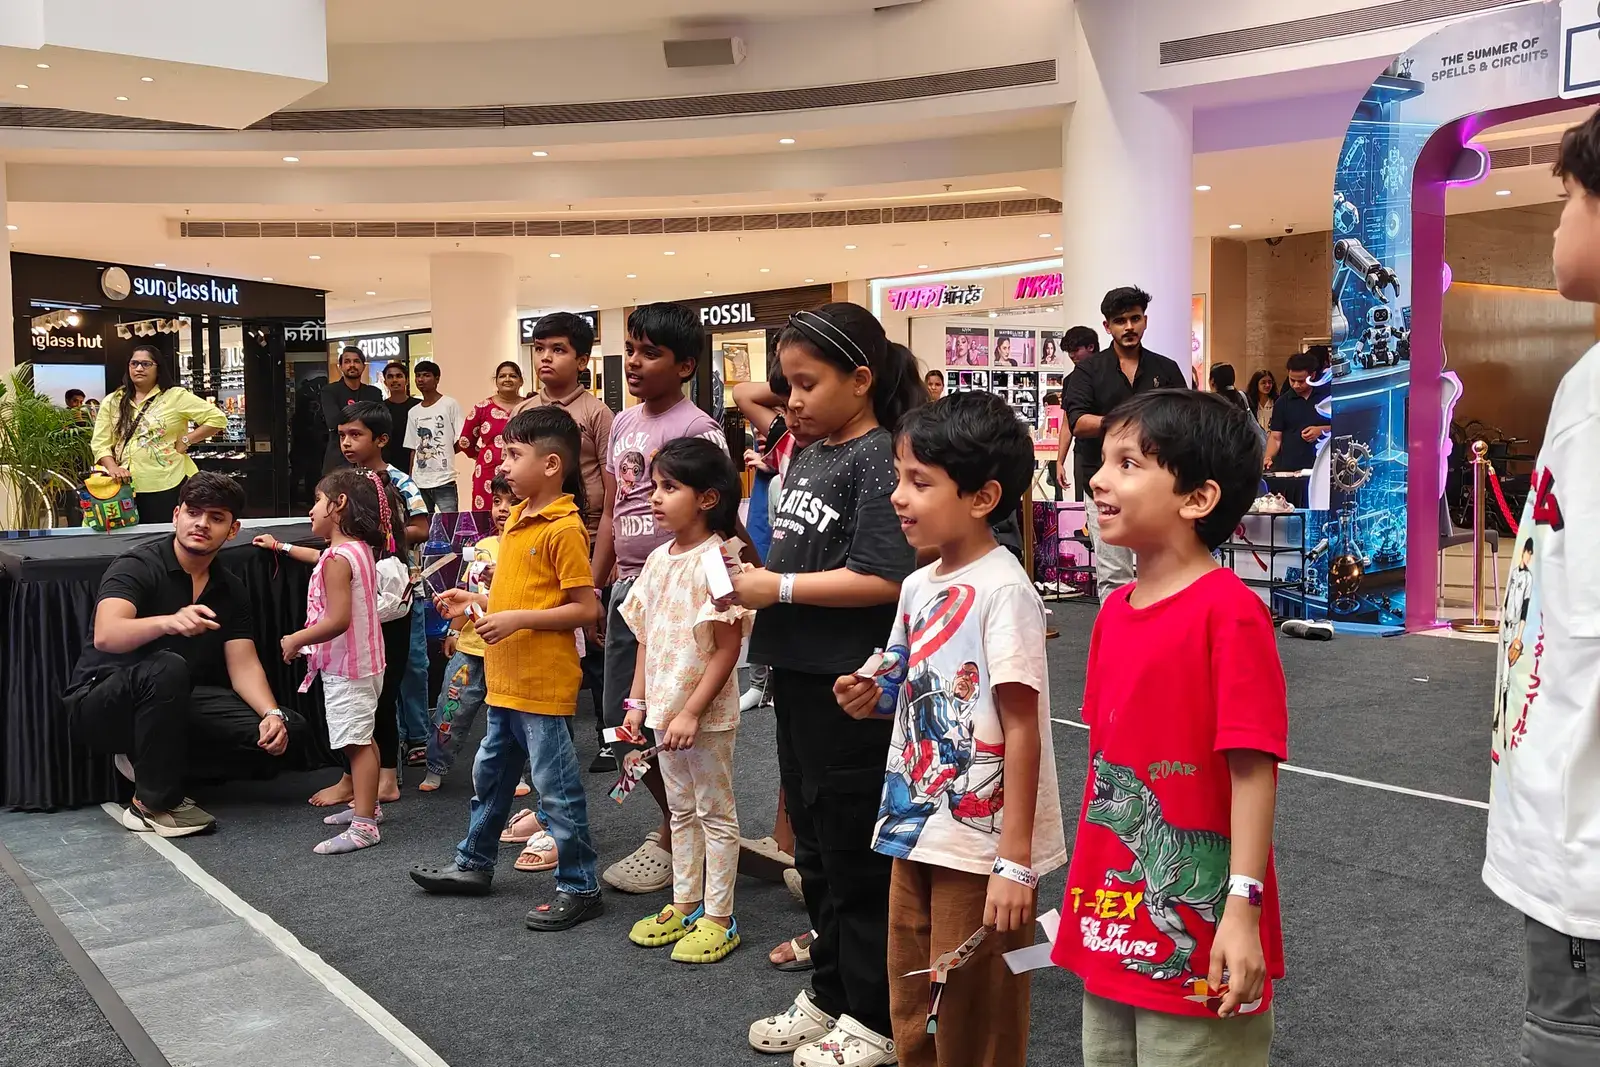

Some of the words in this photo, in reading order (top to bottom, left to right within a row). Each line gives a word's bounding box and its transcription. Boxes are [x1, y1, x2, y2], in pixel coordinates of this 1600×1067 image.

[1441, 53, 1464, 67] THE
[1467, 42, 1518, 61] SUMMER
[1521, 37, 1540, 49] OF
[1431, 63, 1476, 82] SPELLS
[1479, 62, 1488, 72] &
[1491, 48, 1549, 69] CIRCUITS
[133, 275, 209, 305] sunglass
[211, 280, 239, 305] hut
[700, 302, 756, 326] FOSSIL
[77, 333, 103, 348] hut
[357, 336, 400, 358] GUESS
[621, 514, 655, 537] RIDE
[1147, 760, 1197, 783] ROAR
[1106, 921, 1132, 939] OF
